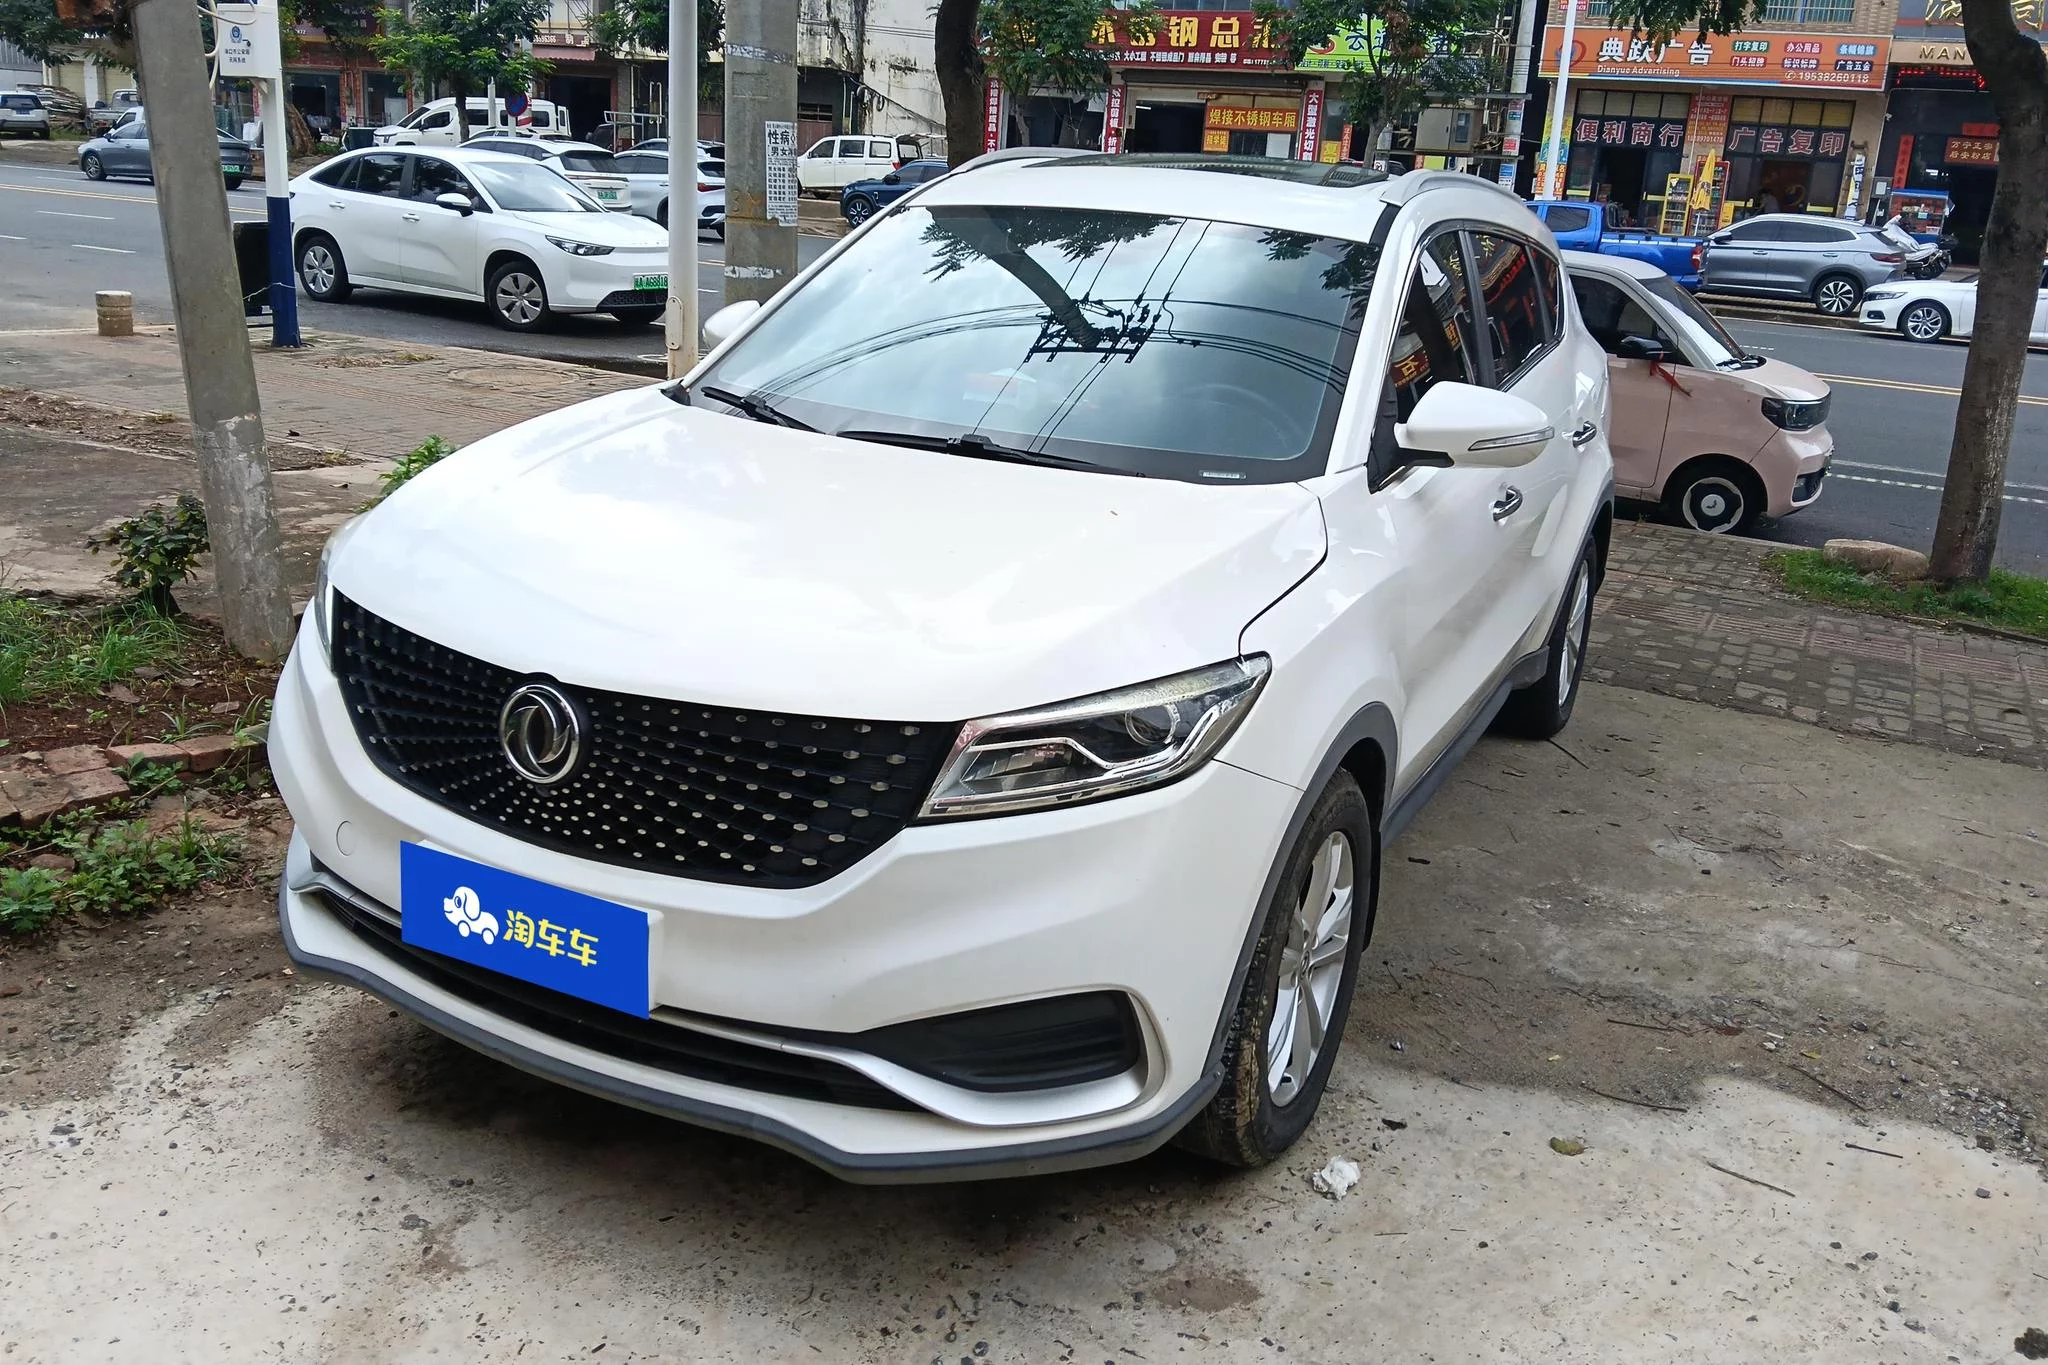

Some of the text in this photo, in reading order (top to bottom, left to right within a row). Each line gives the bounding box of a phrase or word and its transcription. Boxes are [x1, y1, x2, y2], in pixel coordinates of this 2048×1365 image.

[1598, 37, 1713, 66] 典跃广告
[1734, 41, 1769, 52] 打字复印
[1786, 43, 1820, 54] 办公用品
[1731, 56, 1765, 67] 门头招牌
[1836, 60, 1872, 72] 广告五金
[1209, 108, 1297, 128] 焊接不锈钢车厢
[1576, 118, 1684, 148] 便利商行
[1728, 126, 1846, 157] 广告复印
